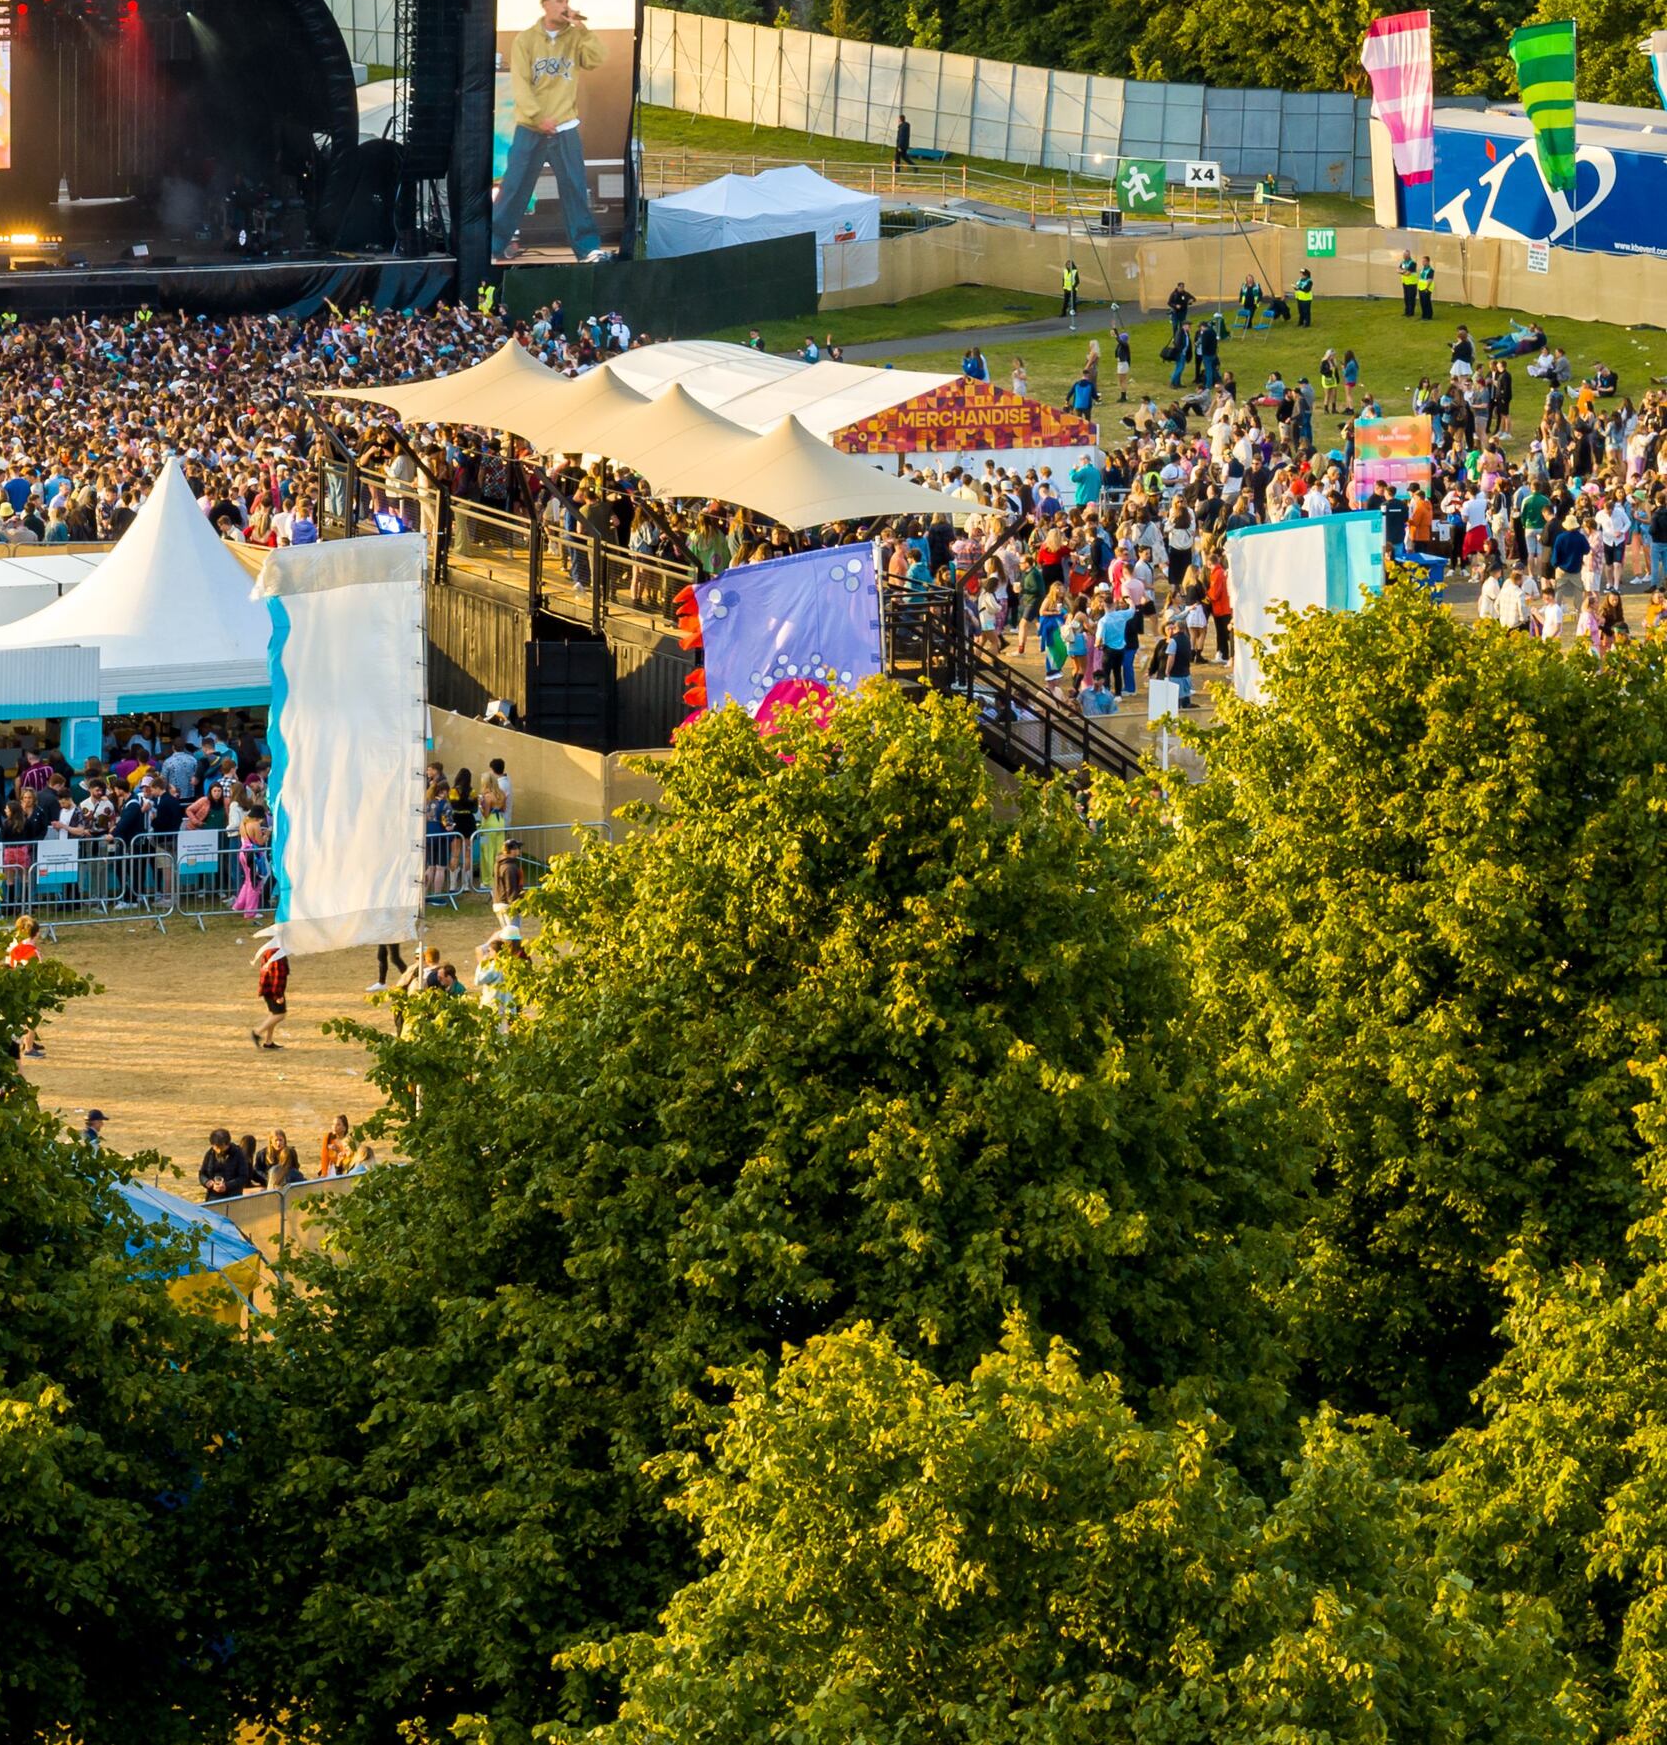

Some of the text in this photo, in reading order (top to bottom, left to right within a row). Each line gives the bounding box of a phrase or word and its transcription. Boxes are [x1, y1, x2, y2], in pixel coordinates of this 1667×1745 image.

[1190, 168, 1215, 181] X4
[1308, 230, 1334, 250] EXIT
[898, 408, 1030, 428] MERCHANDISE
